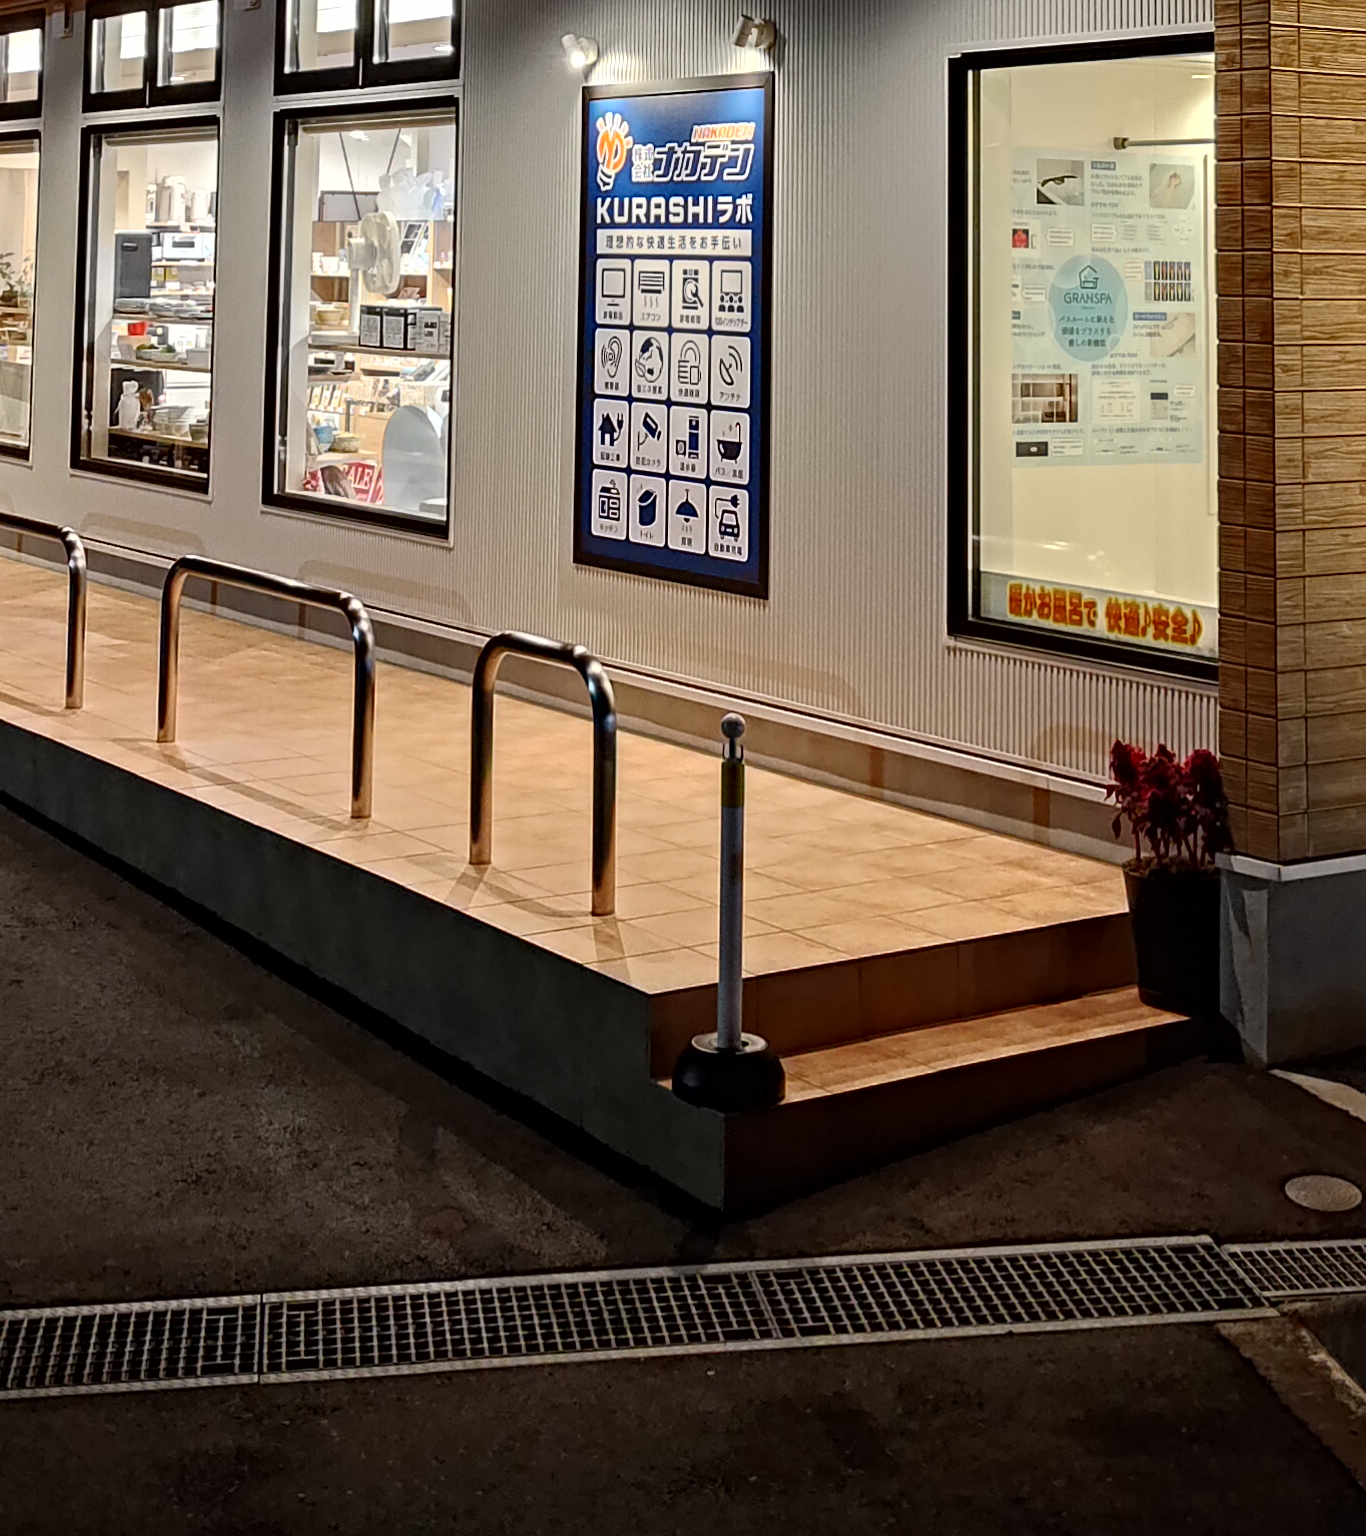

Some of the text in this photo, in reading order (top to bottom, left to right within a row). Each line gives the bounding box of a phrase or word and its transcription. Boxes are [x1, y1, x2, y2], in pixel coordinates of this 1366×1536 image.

[692, 123, 755, 142] NAKADEN
[654, 142, 754, 182] ナカデン
[596, 193, 753, 224] KURASHIラボ
